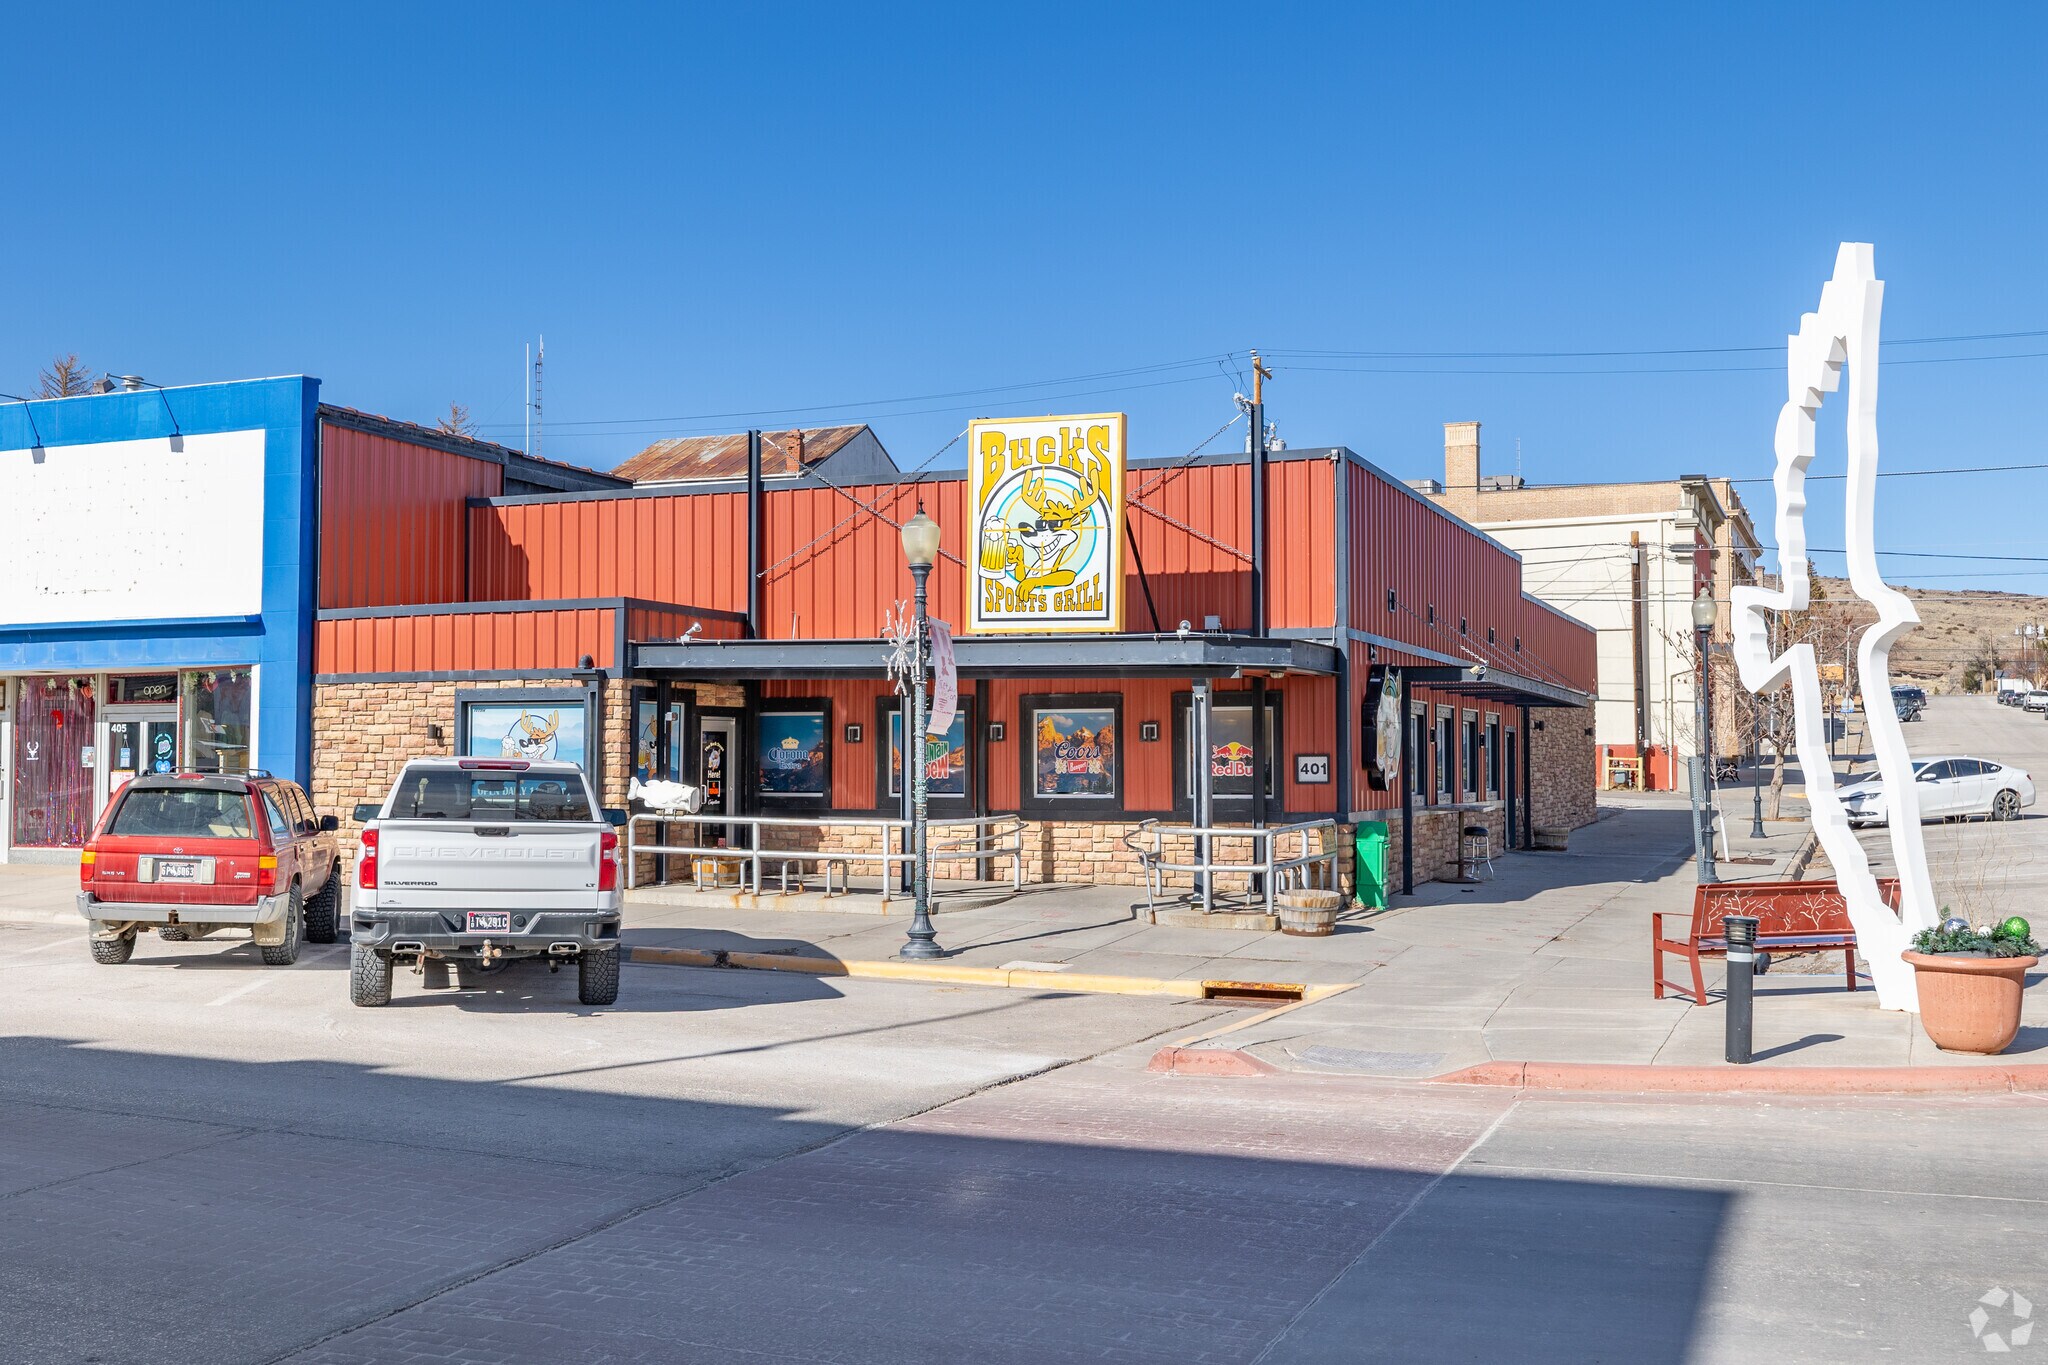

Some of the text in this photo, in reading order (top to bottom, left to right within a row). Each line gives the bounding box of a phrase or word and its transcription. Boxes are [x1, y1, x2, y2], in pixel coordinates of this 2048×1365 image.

[985, 572, 1103, 613] SPORTS GRILL
[143, 684, 167, 697] open
[111, 724, 127, 732] 405
[768, 747, 811, 762] Corona
[1054, 741, 1100, 759] Coors
[779, 761, 802, 769] Extra
[1235, 761, 1253, 776] Bu
[1300, 762, 1327, 775] 401
[708, 770, 720, 778] Here!
[393, 846, 585, 861] CHEVROLET
